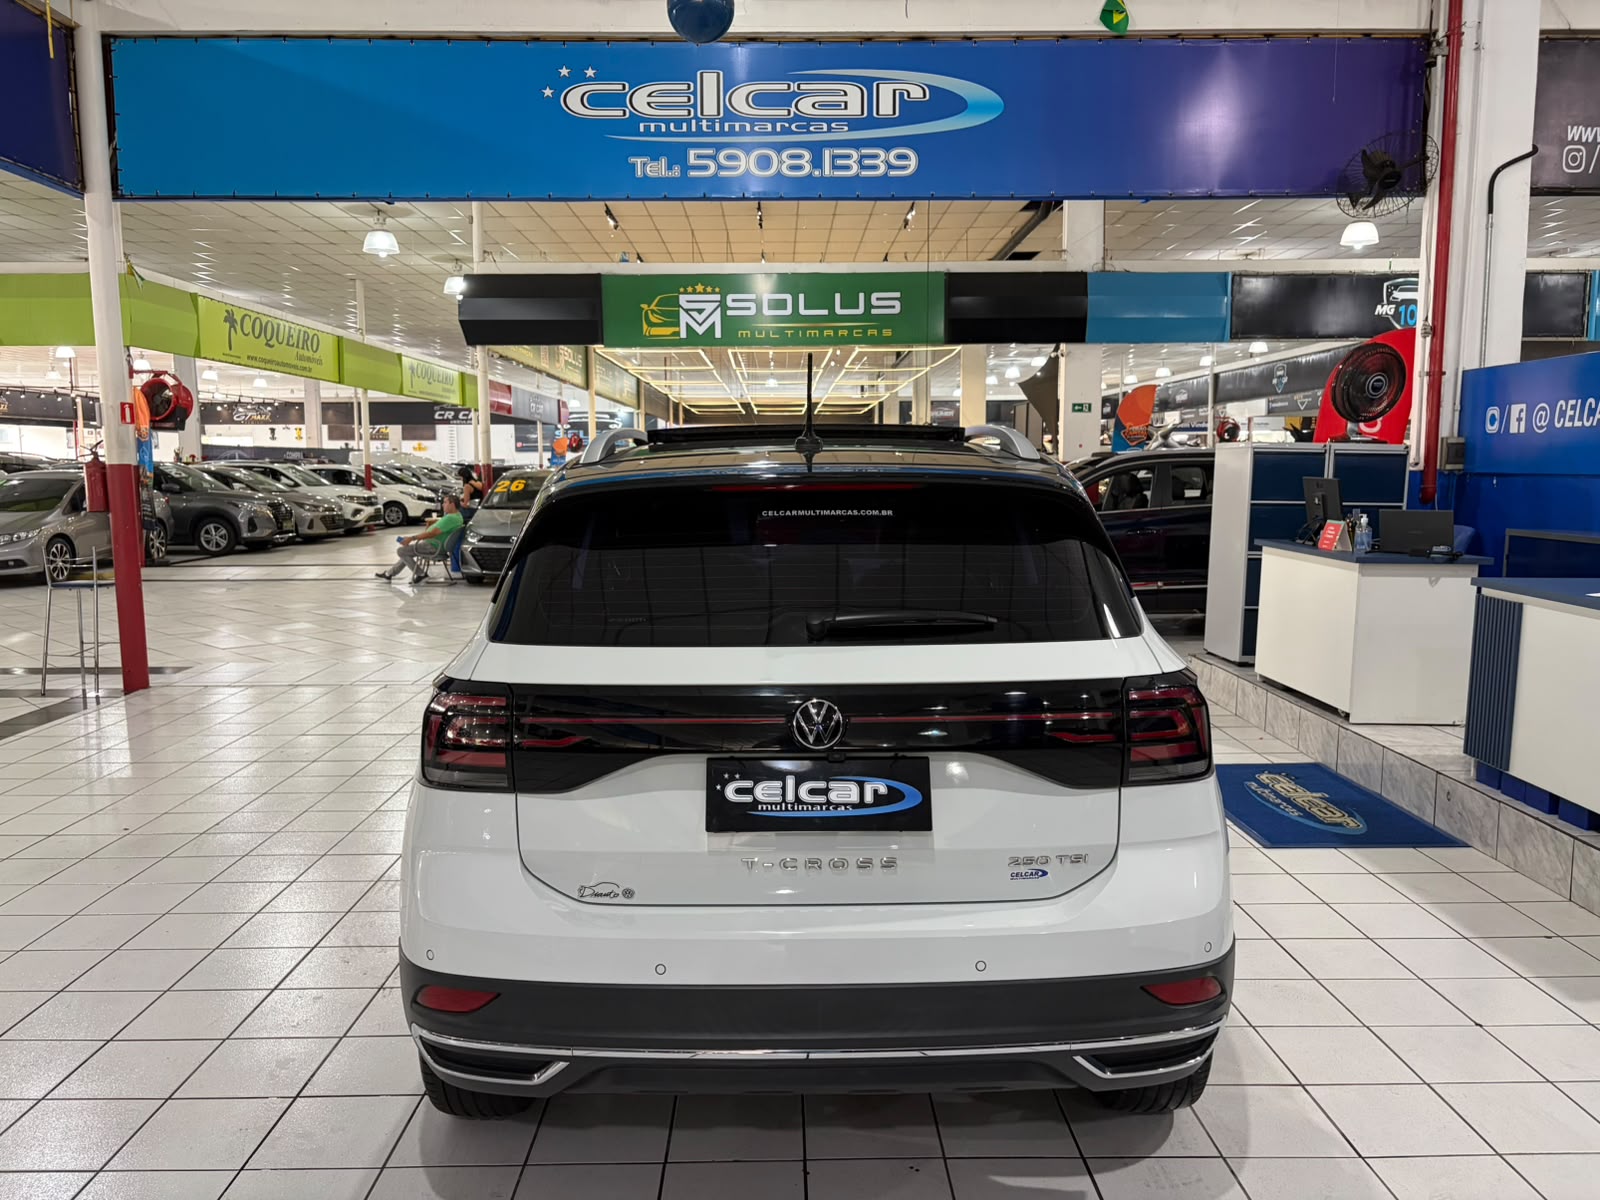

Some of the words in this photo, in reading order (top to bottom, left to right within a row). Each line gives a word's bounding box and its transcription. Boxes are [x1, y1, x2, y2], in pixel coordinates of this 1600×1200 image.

[561, 70, 930, 118] celcar
[639, 119, 849, 133] multimarcas
[687, 147, 919, 178] 5908.1339
[726, 291, 902, 316] SOLUS
[1374, 304, 1396, 316] MG
[240, 312, 321, 354] COQUEIRO
[738, 328, 893, 338] MULTIMARCAS
[415, 362, 455, 386] COQUEIRO
[433, 410, 456, 420] CR
[494, 479, 527, 493] 26
[761, 509, 893, 517] CELCARMULTIMARCAS.COM.BR
[724, 775, 888, 804] celcar
[757, 802, 854, 813] multimarcas
[740, 857, 899, 872] T-CROSS
[1007, 855, 1051, 868] 250
[1055, 853, 1089, 865] TSI
[1010, 870, 1040, 878] CELCAR
